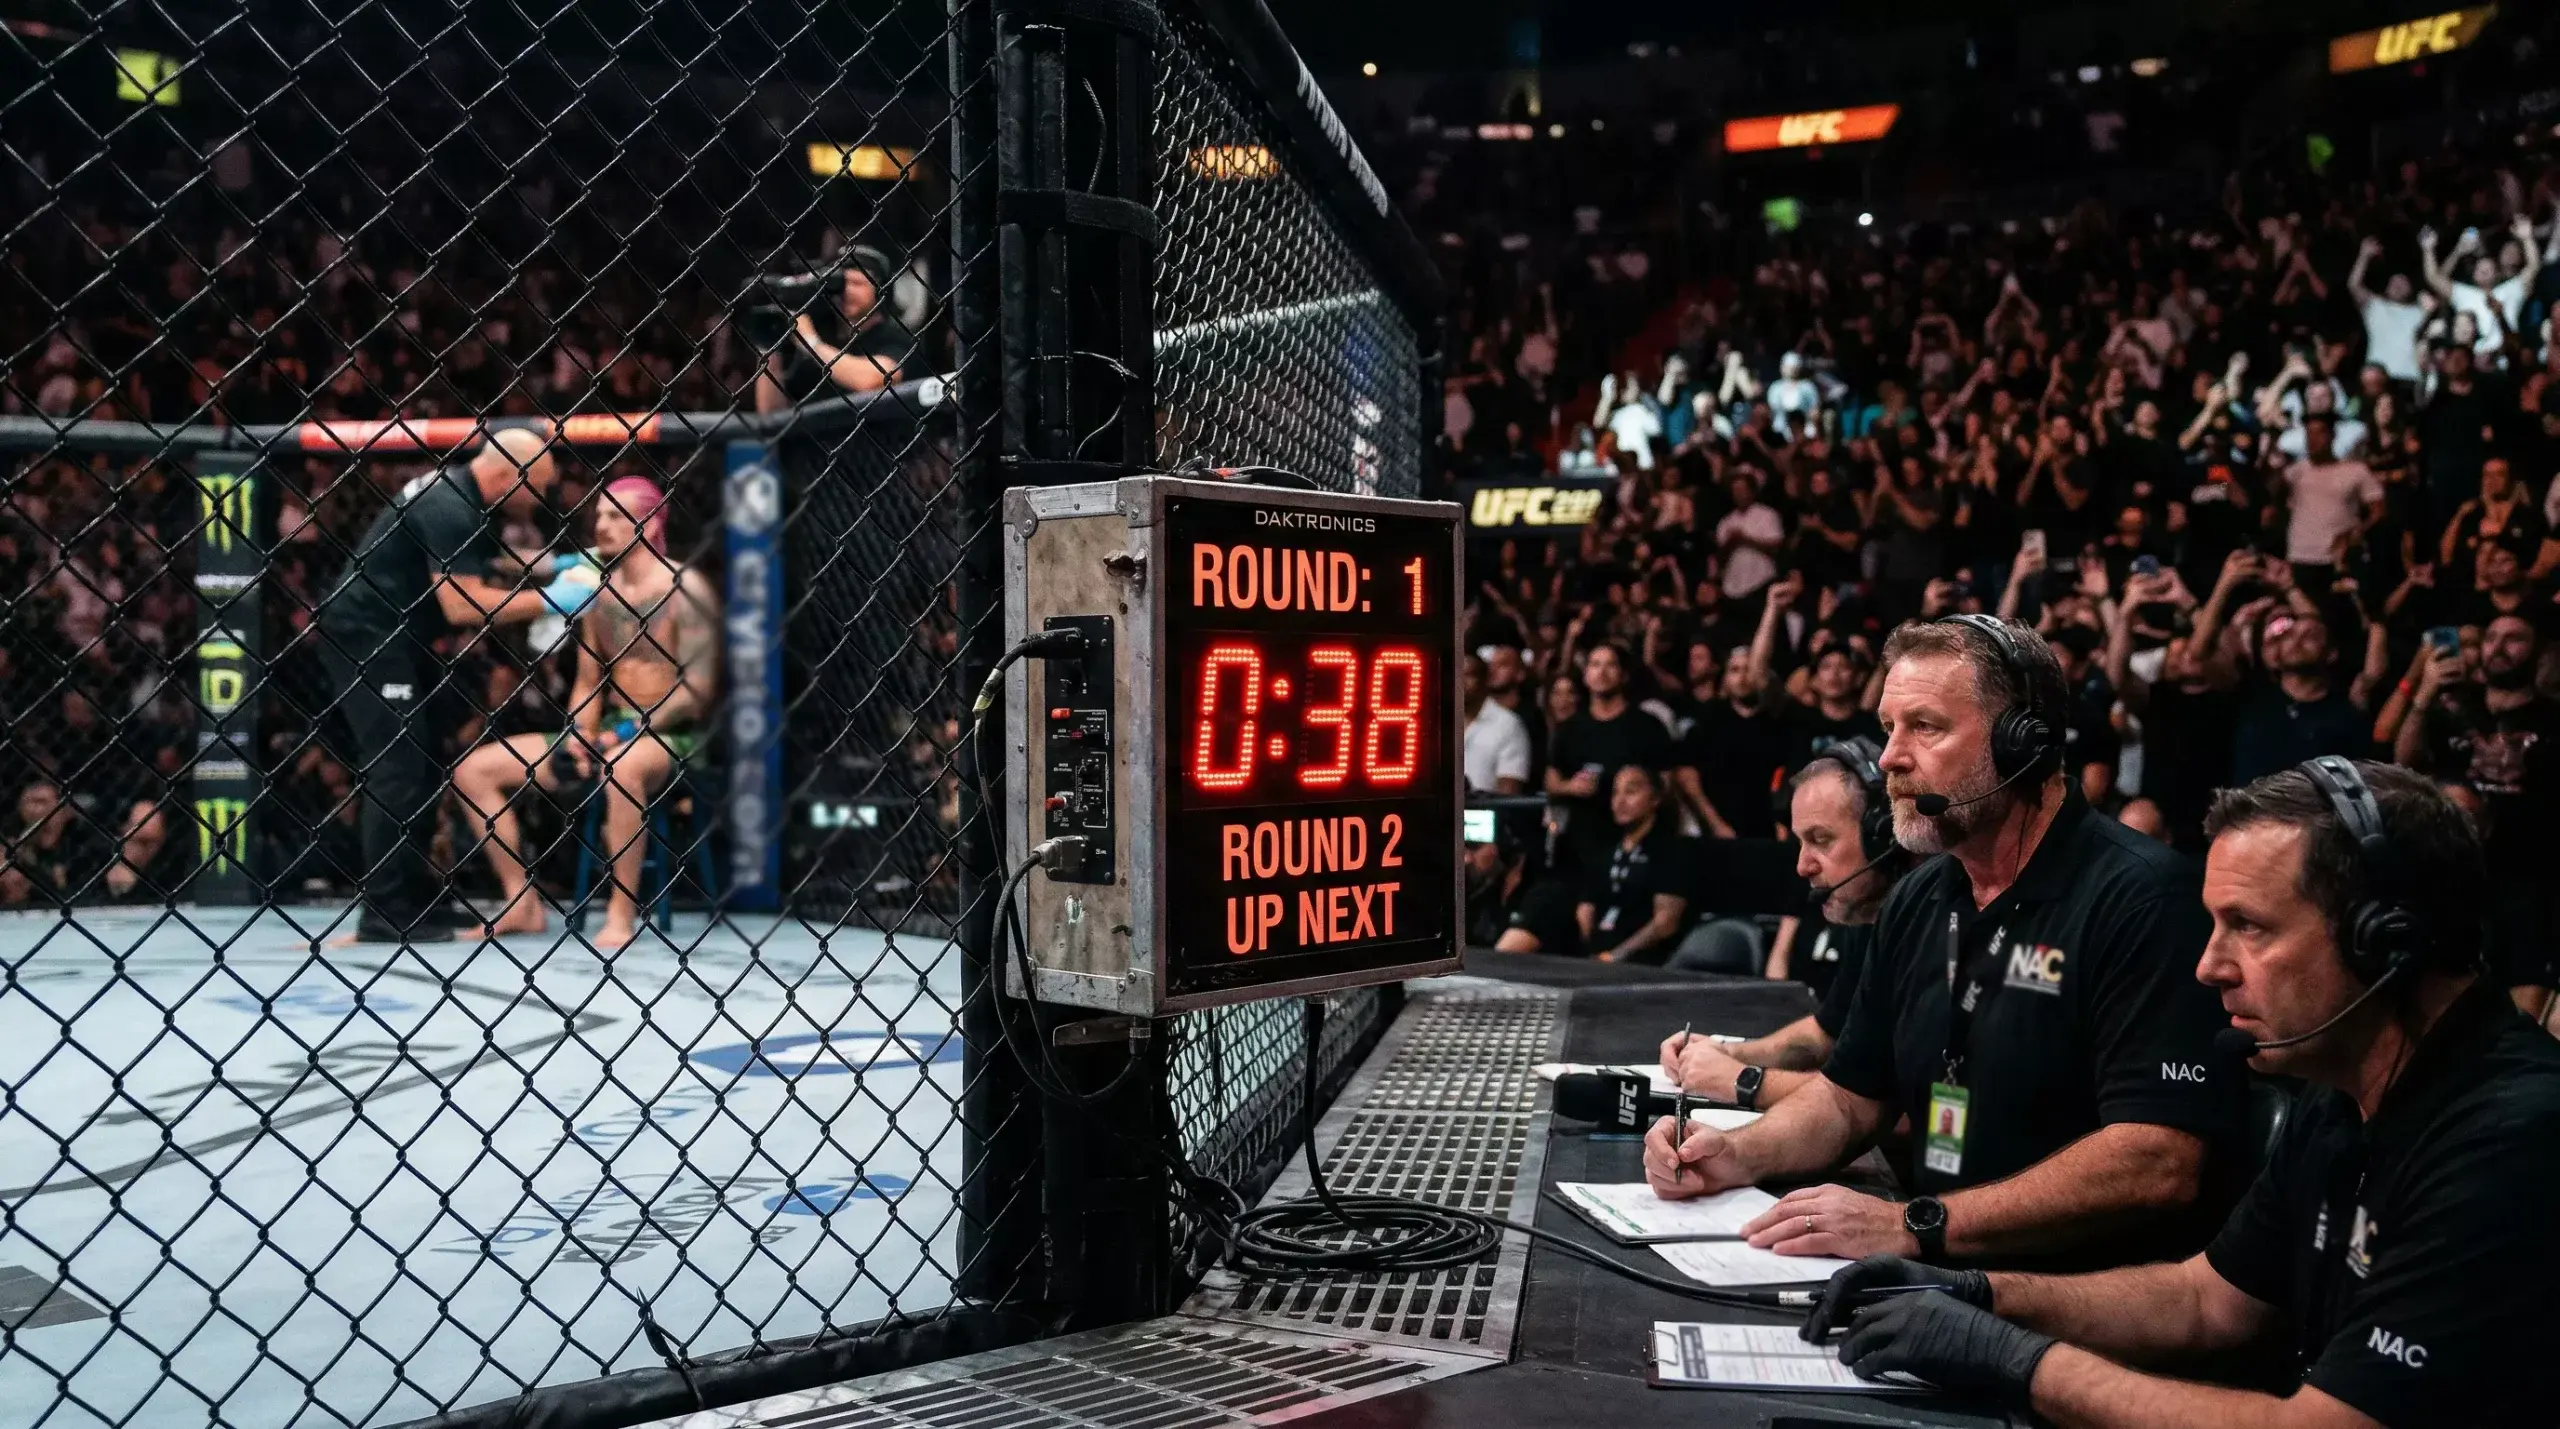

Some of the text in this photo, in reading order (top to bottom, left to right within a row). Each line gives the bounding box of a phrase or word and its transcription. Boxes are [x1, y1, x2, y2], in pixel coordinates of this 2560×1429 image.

[2374, 12, 2462, 64] UFC
[1255, 510, 1376, 533] DAKTRONICS
[1471, 487, 1556, 527] UFC
[1193, 543, 1422, 615] ROUND: 1
[1197, 647, 1422, 787] 0:38
[1223, 813, 1403, 881] ROUND 2
[1227, 882, 1400, 954] UP NEXT
[2005, 943, 2066, 983] NAC
[2162, 1062, 2206, 1083] NAC
[1618, 1081, 1638, 1126] UFC
[2367, 1326, 2428, 1368] NAC
